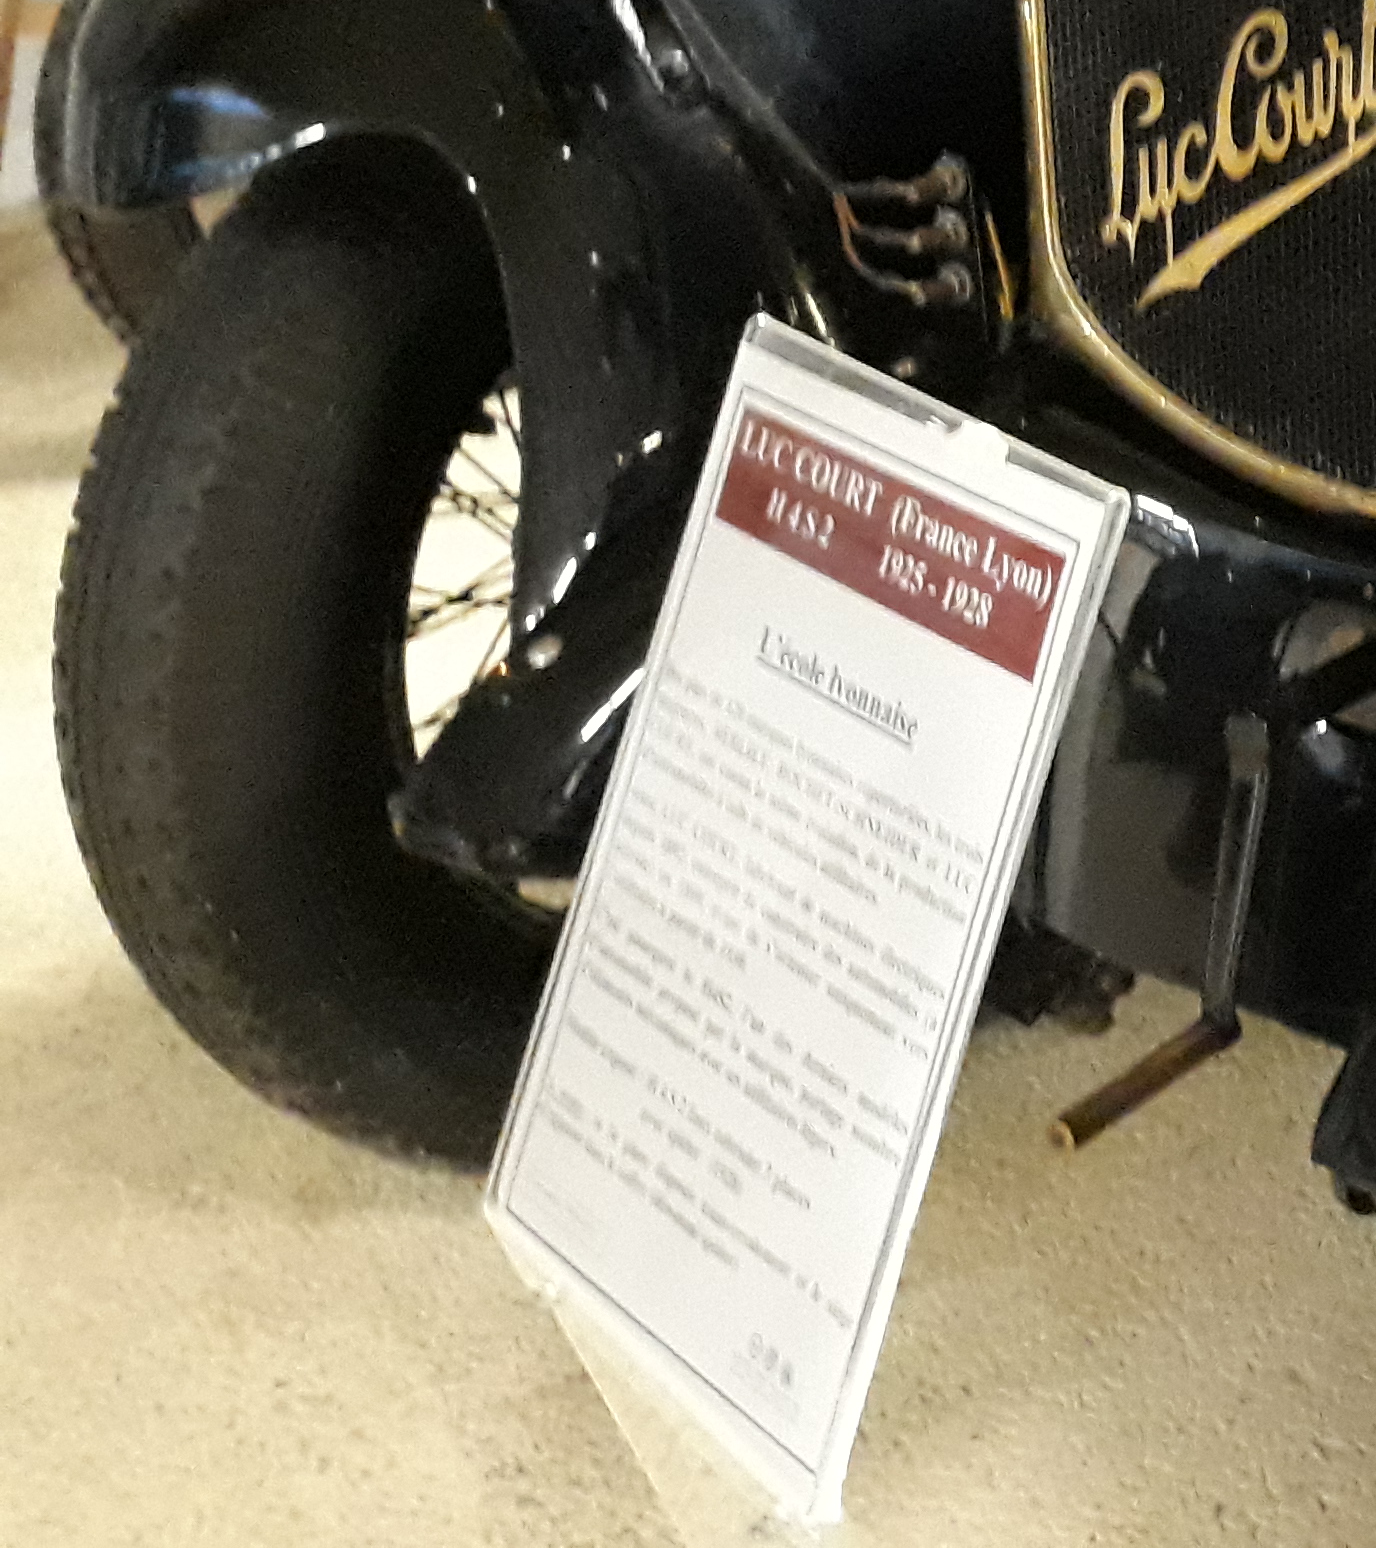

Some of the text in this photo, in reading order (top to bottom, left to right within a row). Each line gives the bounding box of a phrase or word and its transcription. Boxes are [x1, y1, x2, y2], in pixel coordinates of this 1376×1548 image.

[740, 420, 793, 474] LUC
[795, 446, 883, 517] COURT
[941, 575, 994, 629] 1928
